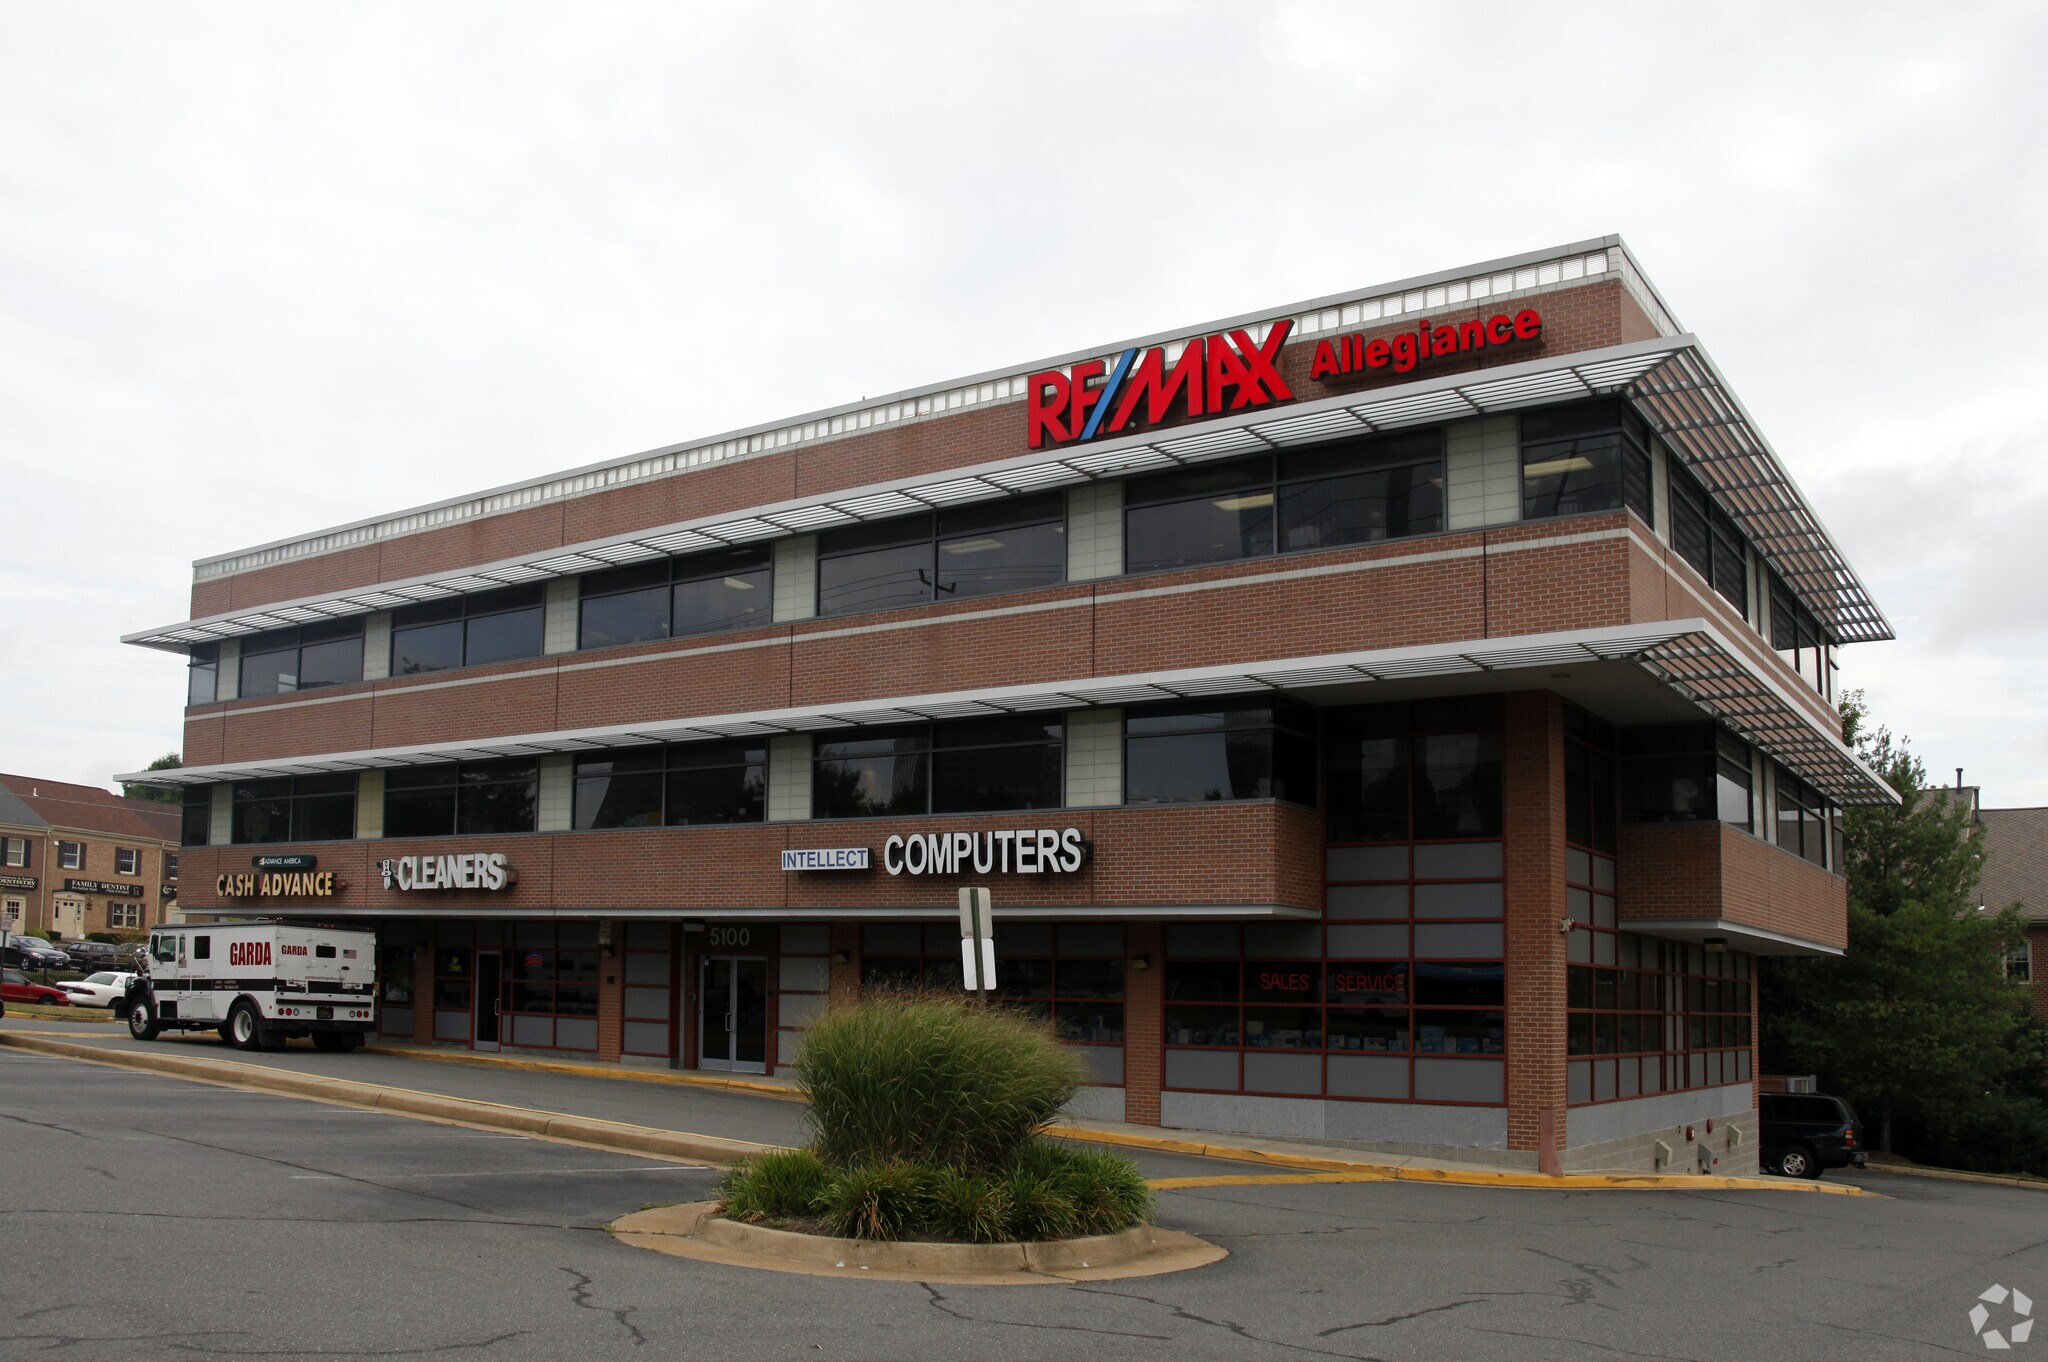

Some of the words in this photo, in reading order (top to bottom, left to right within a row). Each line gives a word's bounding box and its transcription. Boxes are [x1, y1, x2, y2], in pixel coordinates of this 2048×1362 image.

[1027, 319, 1293, 449] RE/MAX
[1310, 308, 1543, 382] Allegiance
[783, 849, 868, 869] INTELLECT
[884, 827, 1082, 876] COMPUTERS
[216, 873, 254, 897] CASH
[261, 872, 333, 896] ADVANCE
[398, 853, 508, 891] CLEANERS
[72, 880, 98, 888] FAMILY
[101, 882, 130, 891] DENTIST
[710, 927, 750, 946] 5100
[230, 941, 272, 966] GARDA
[281, 944, 308, 956] GARDA
[1260, 972, 1309, 991] SALES
[1335, 973, 1405, 992] SERVICE
